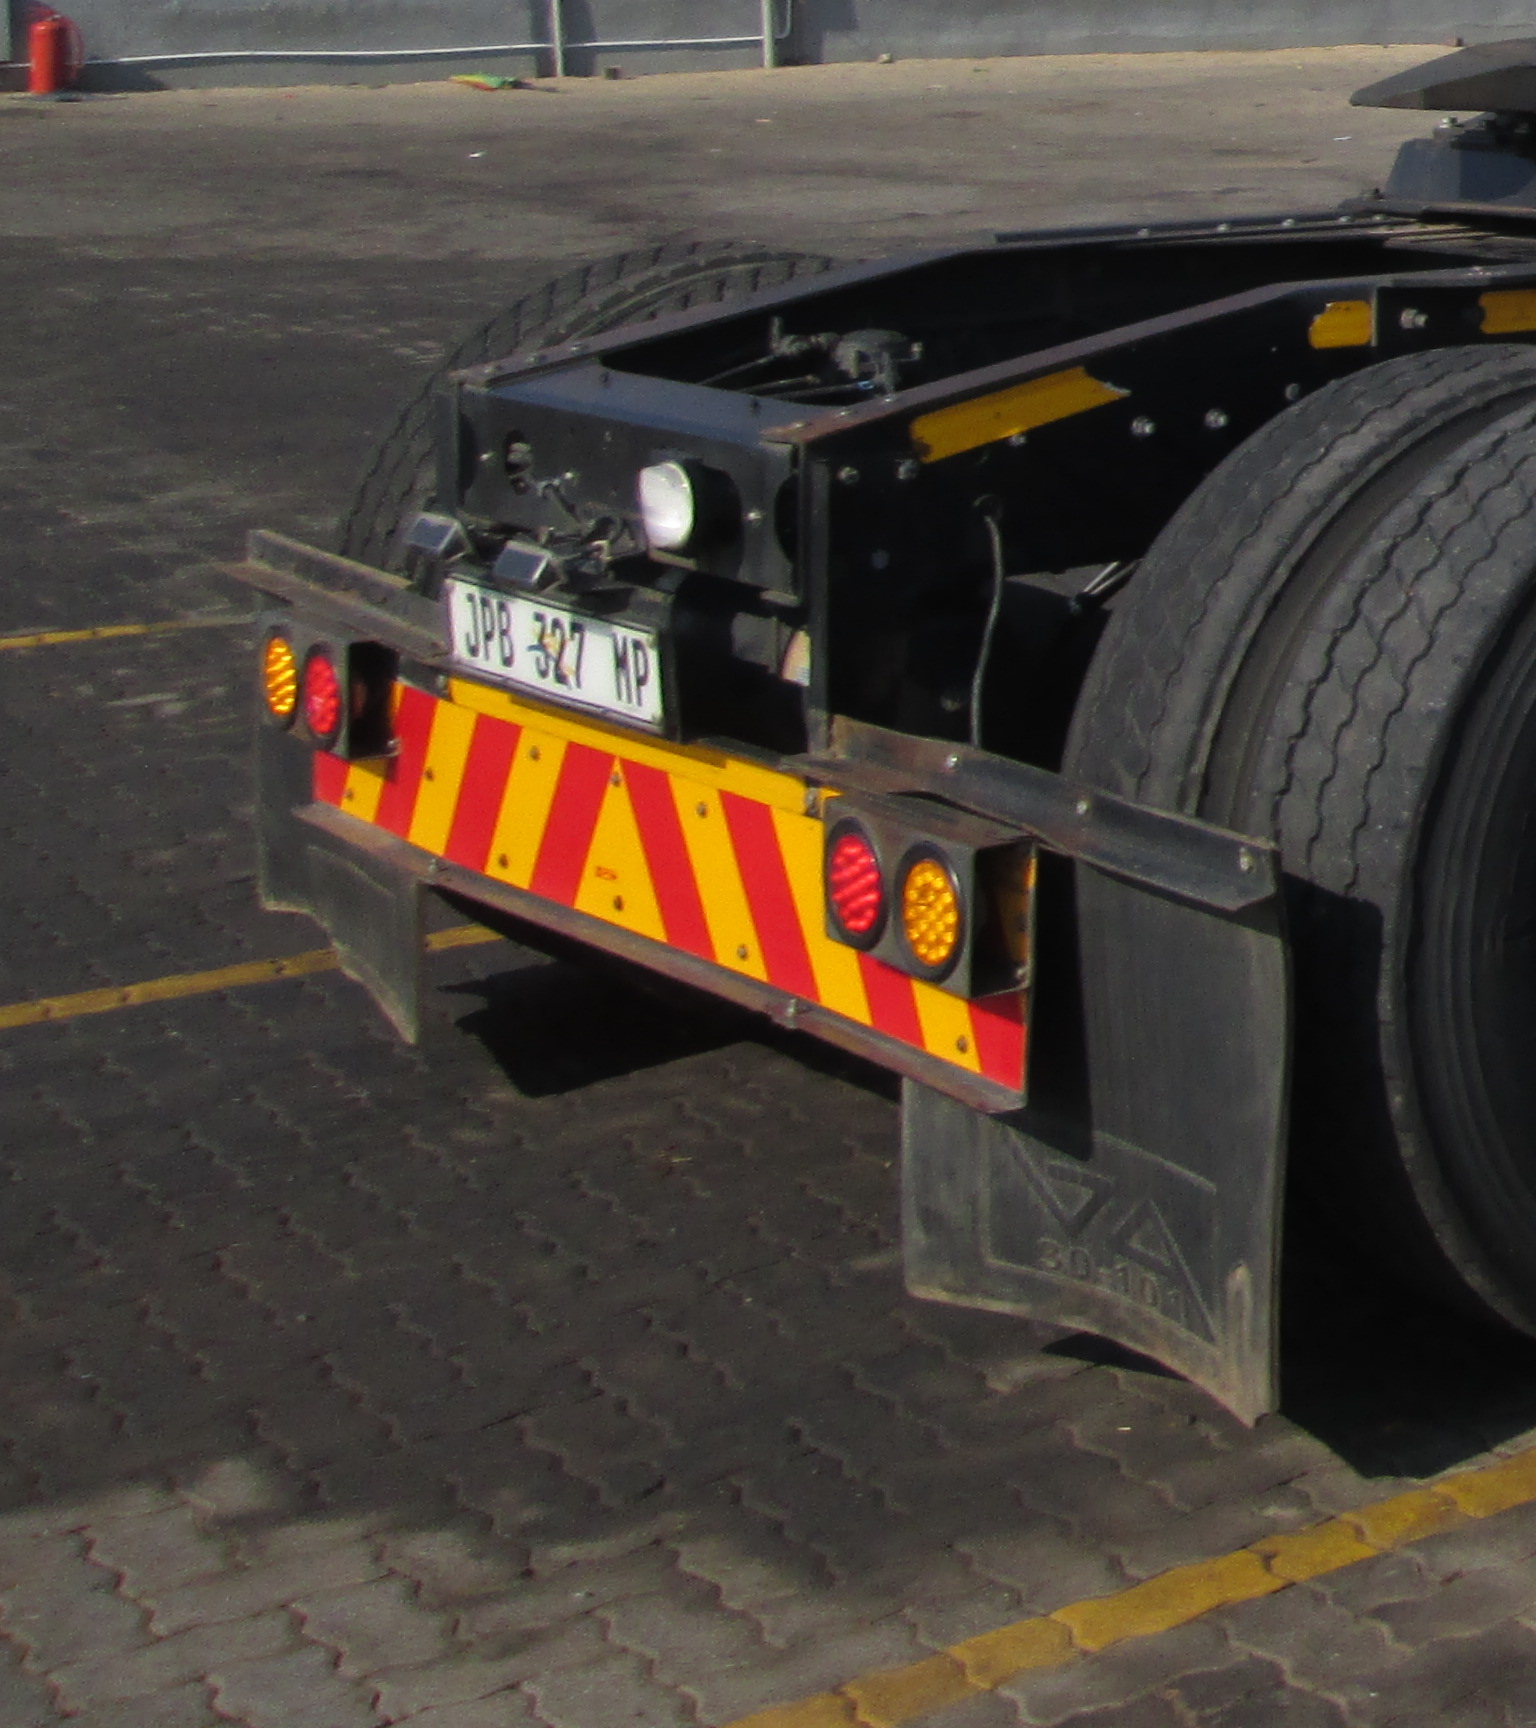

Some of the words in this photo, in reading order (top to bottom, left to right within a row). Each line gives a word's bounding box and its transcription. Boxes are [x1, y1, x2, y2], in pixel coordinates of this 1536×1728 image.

[464, 592, 516, 668] JPB
[529, 610, 587, 690] 327
[612, 631, 652, 707] MP
